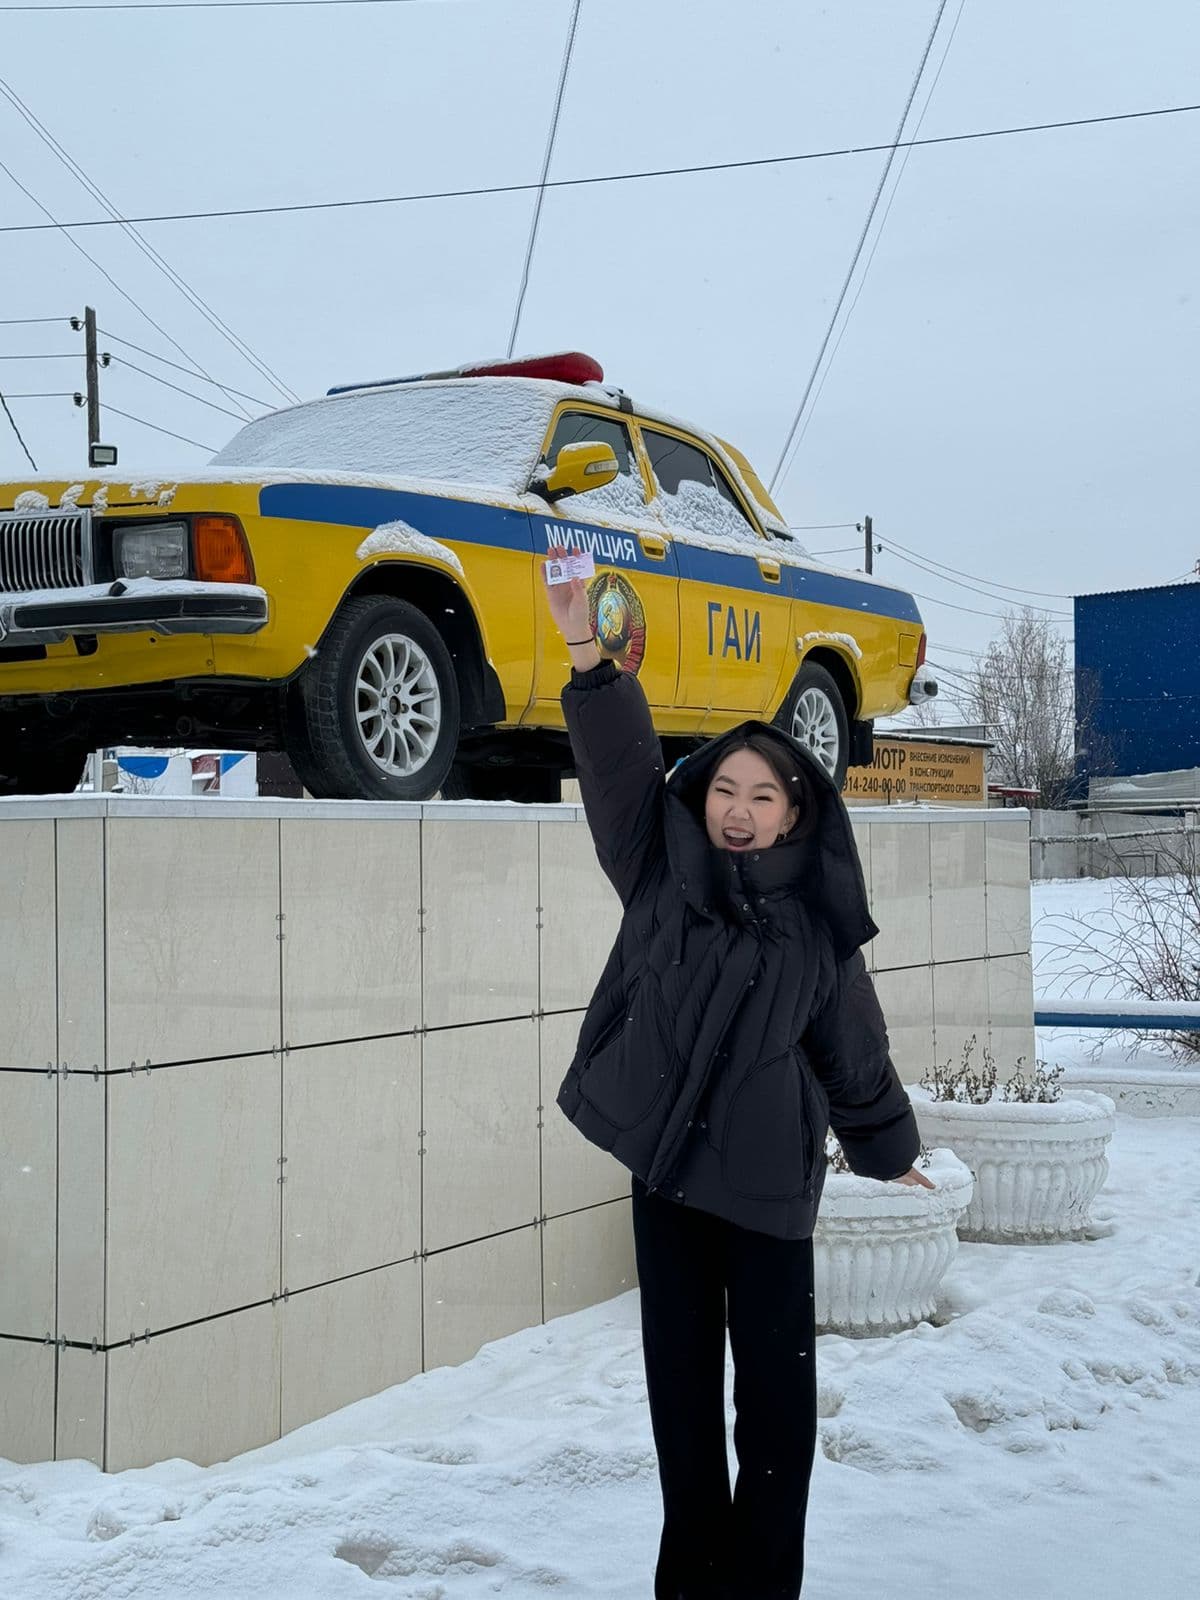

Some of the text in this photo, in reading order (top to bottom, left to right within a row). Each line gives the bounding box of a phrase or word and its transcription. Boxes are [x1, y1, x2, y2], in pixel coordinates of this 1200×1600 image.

[707, 601, 760, 663] ГАИ
[867, 747, 906, 770] МОТР
[909, 751, 937, 763] ВНЕСЕНИЕ
[909, 767, 954, 780] В КОНСТРУКЦИИ
[909, 782, 981, 795] ТРАНСПОРТНОГО СРЕДСТВА
